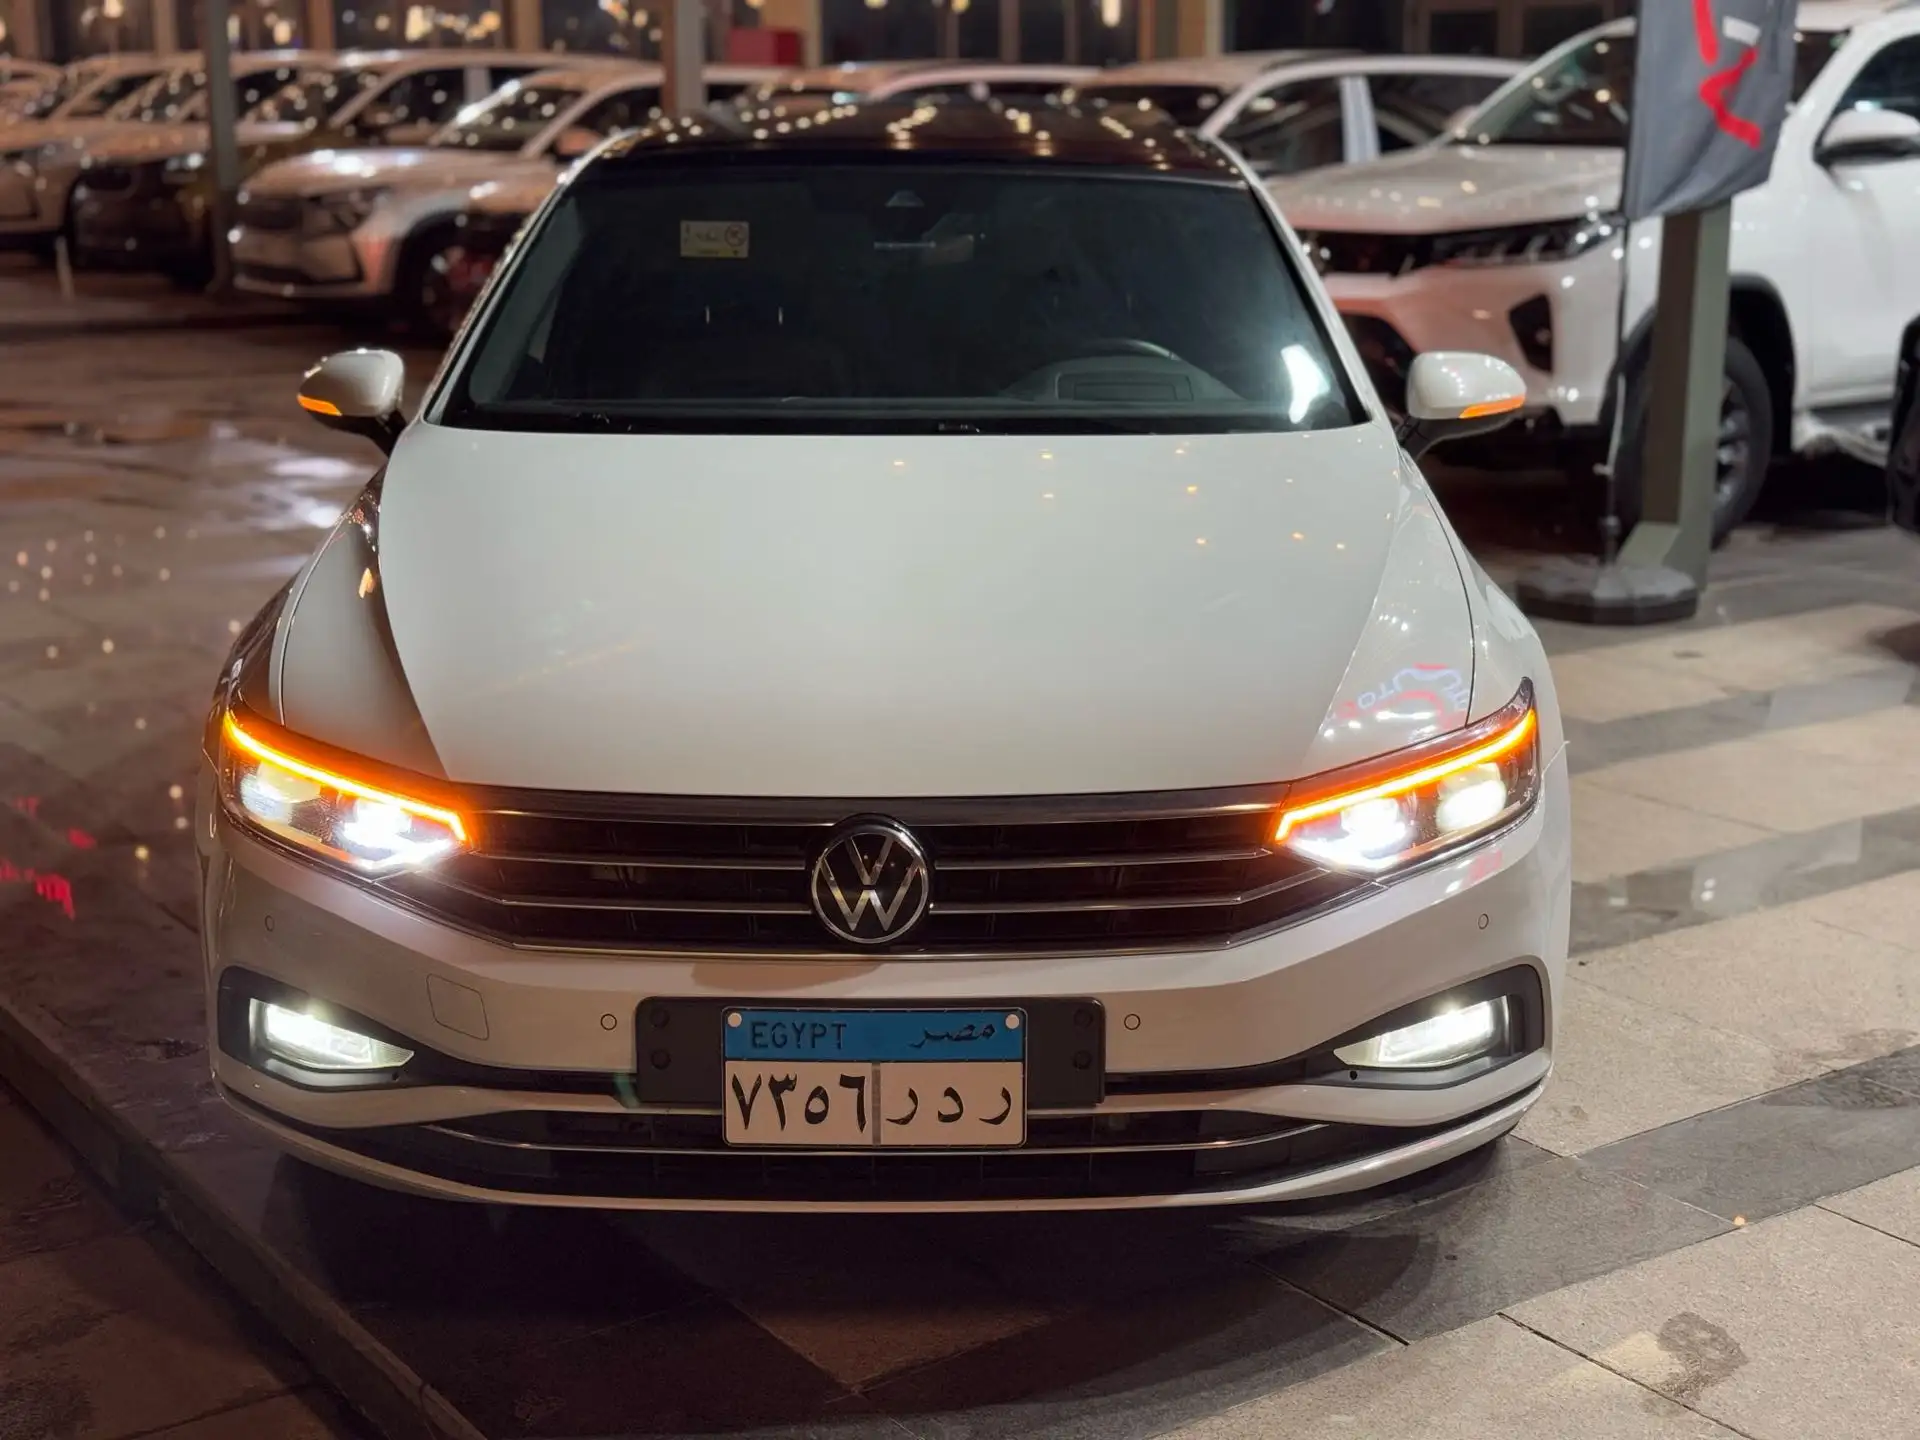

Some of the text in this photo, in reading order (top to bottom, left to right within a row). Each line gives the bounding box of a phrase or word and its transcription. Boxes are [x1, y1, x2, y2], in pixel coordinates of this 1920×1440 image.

[816, 830, 925, 932] VW
[751, 1021, 848, 1049] EGYPT
[910, 1023, 997, 1049] مصر
[731, 1073, 867, 1134] ٧٣٥٦
